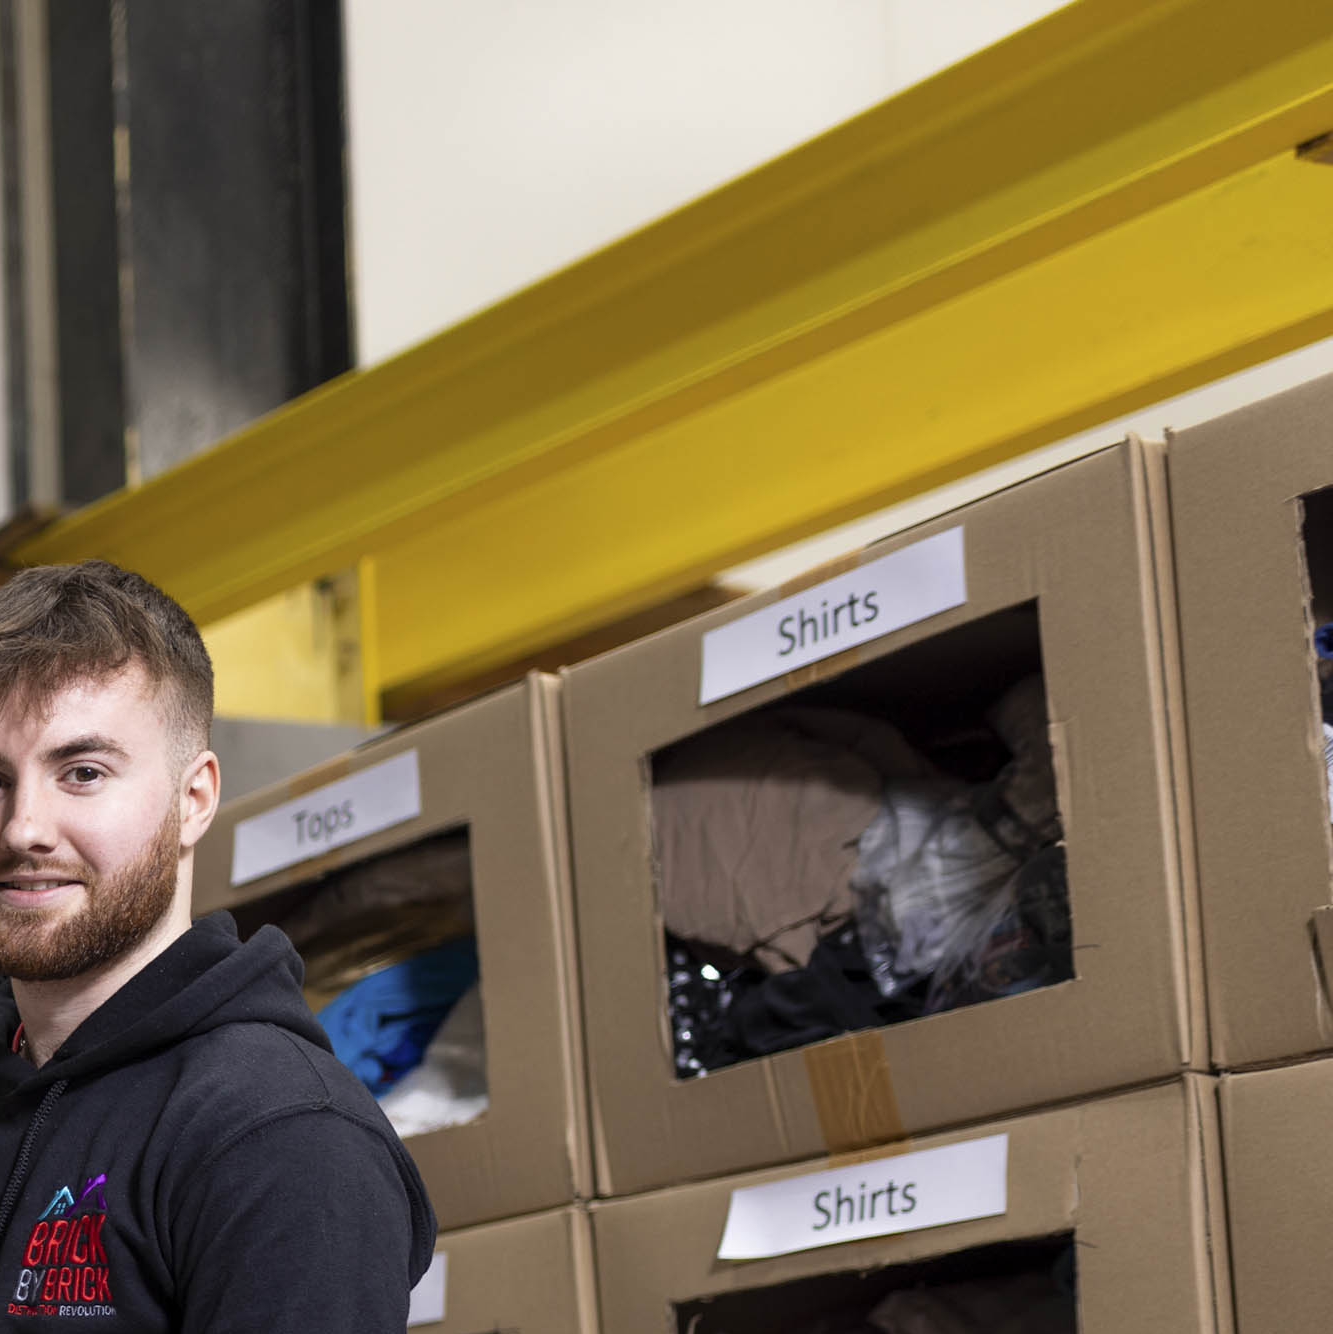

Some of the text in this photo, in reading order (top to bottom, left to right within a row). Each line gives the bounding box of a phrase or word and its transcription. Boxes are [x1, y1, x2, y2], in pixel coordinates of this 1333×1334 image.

[776, 588, 880, 657] Shirts
[293, 801, 356, 847] Tops
[812, 1176, 918, 1231] Shirts
[22, 1213, 108, 1266] BRICK
[14, 1266, 113, 1302] BY BRICK
[59, 1304, 117, 1317] REVOLUTION
